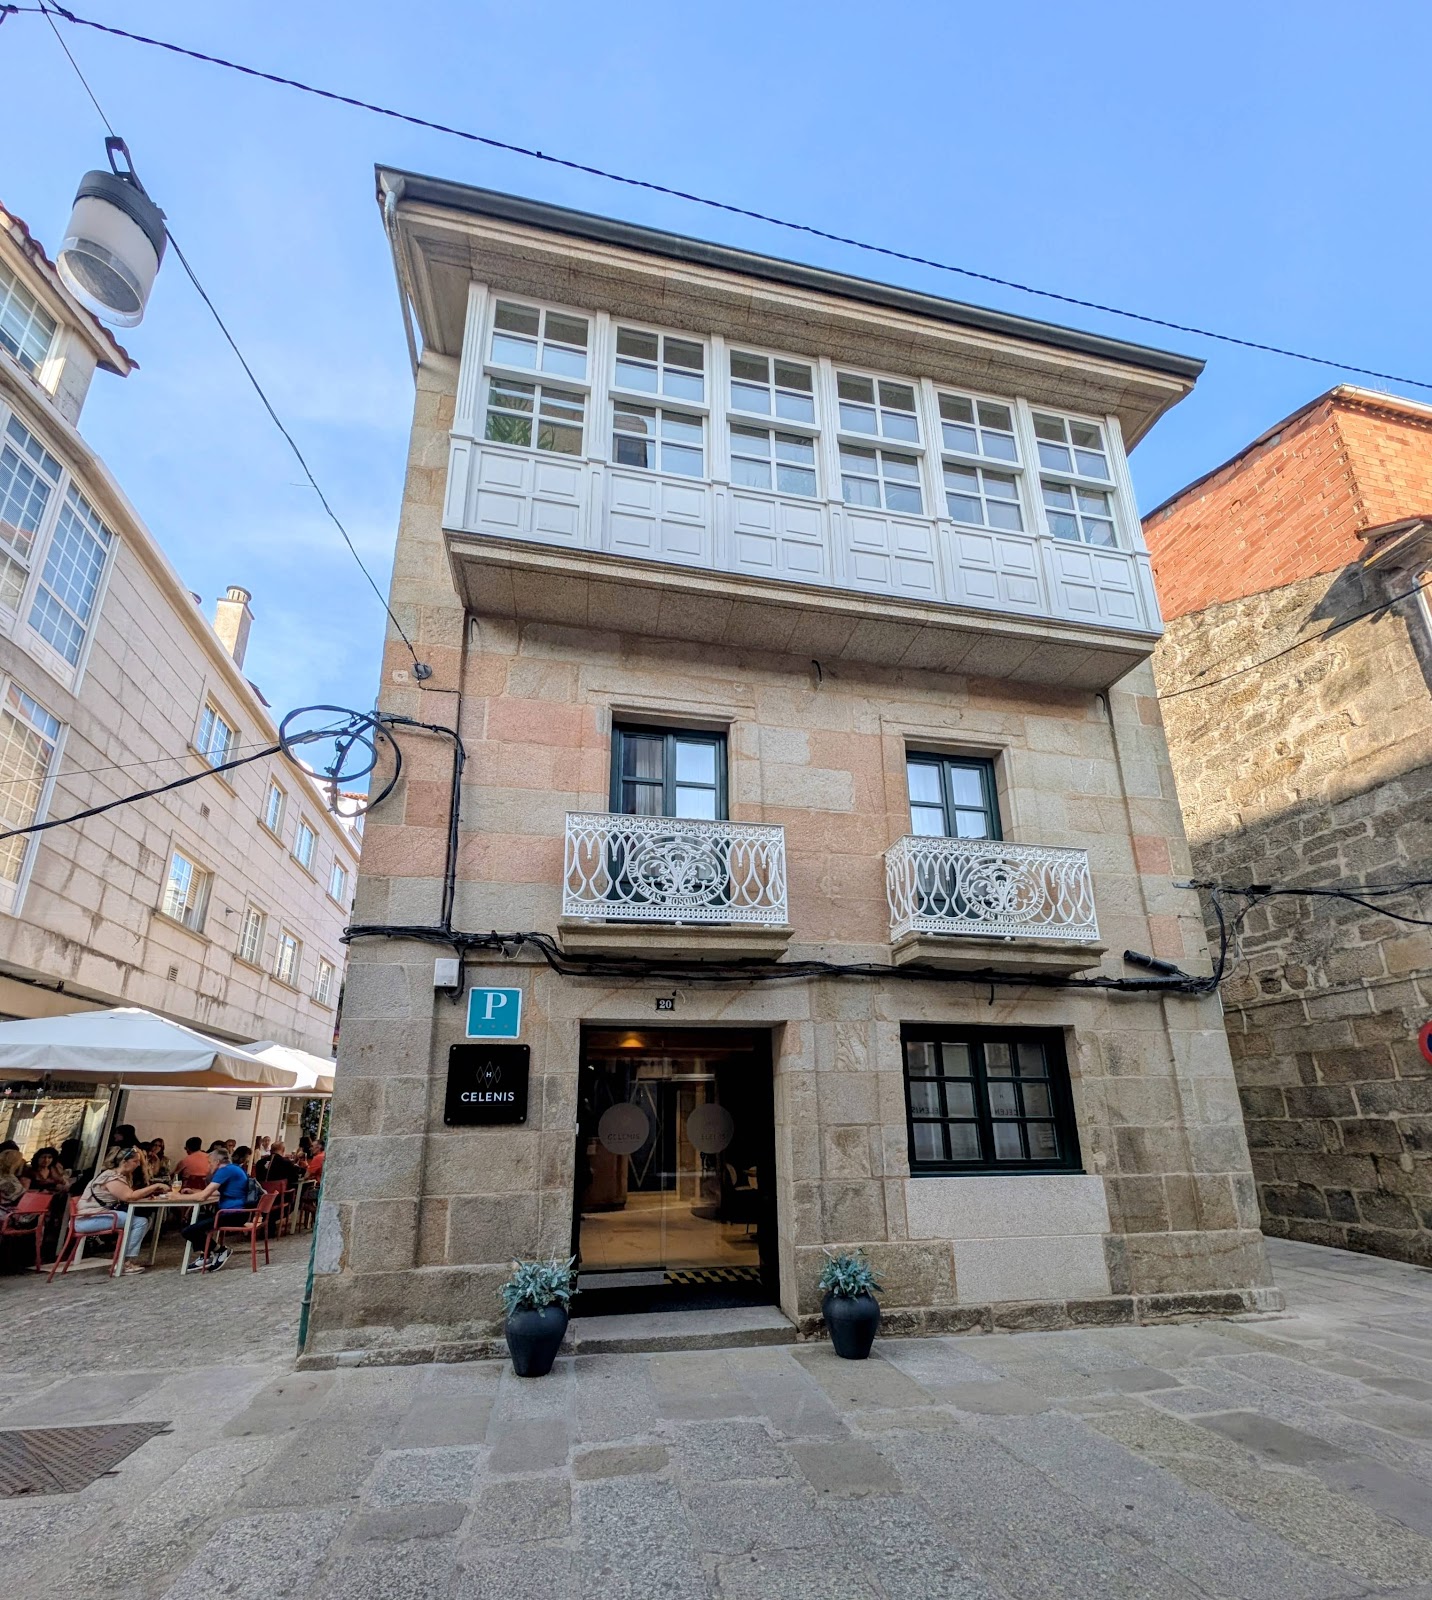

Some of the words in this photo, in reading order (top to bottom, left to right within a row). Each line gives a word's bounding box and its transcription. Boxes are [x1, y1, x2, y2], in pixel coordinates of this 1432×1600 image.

[636, 879, 662, 901] TOMAS
[970, 899, 996, 919] TOMAS
[481, 992, 507, 1019] P
[658, 999, 673, 1009] 20
[460, 1091, 515, 1102] CELENIS
